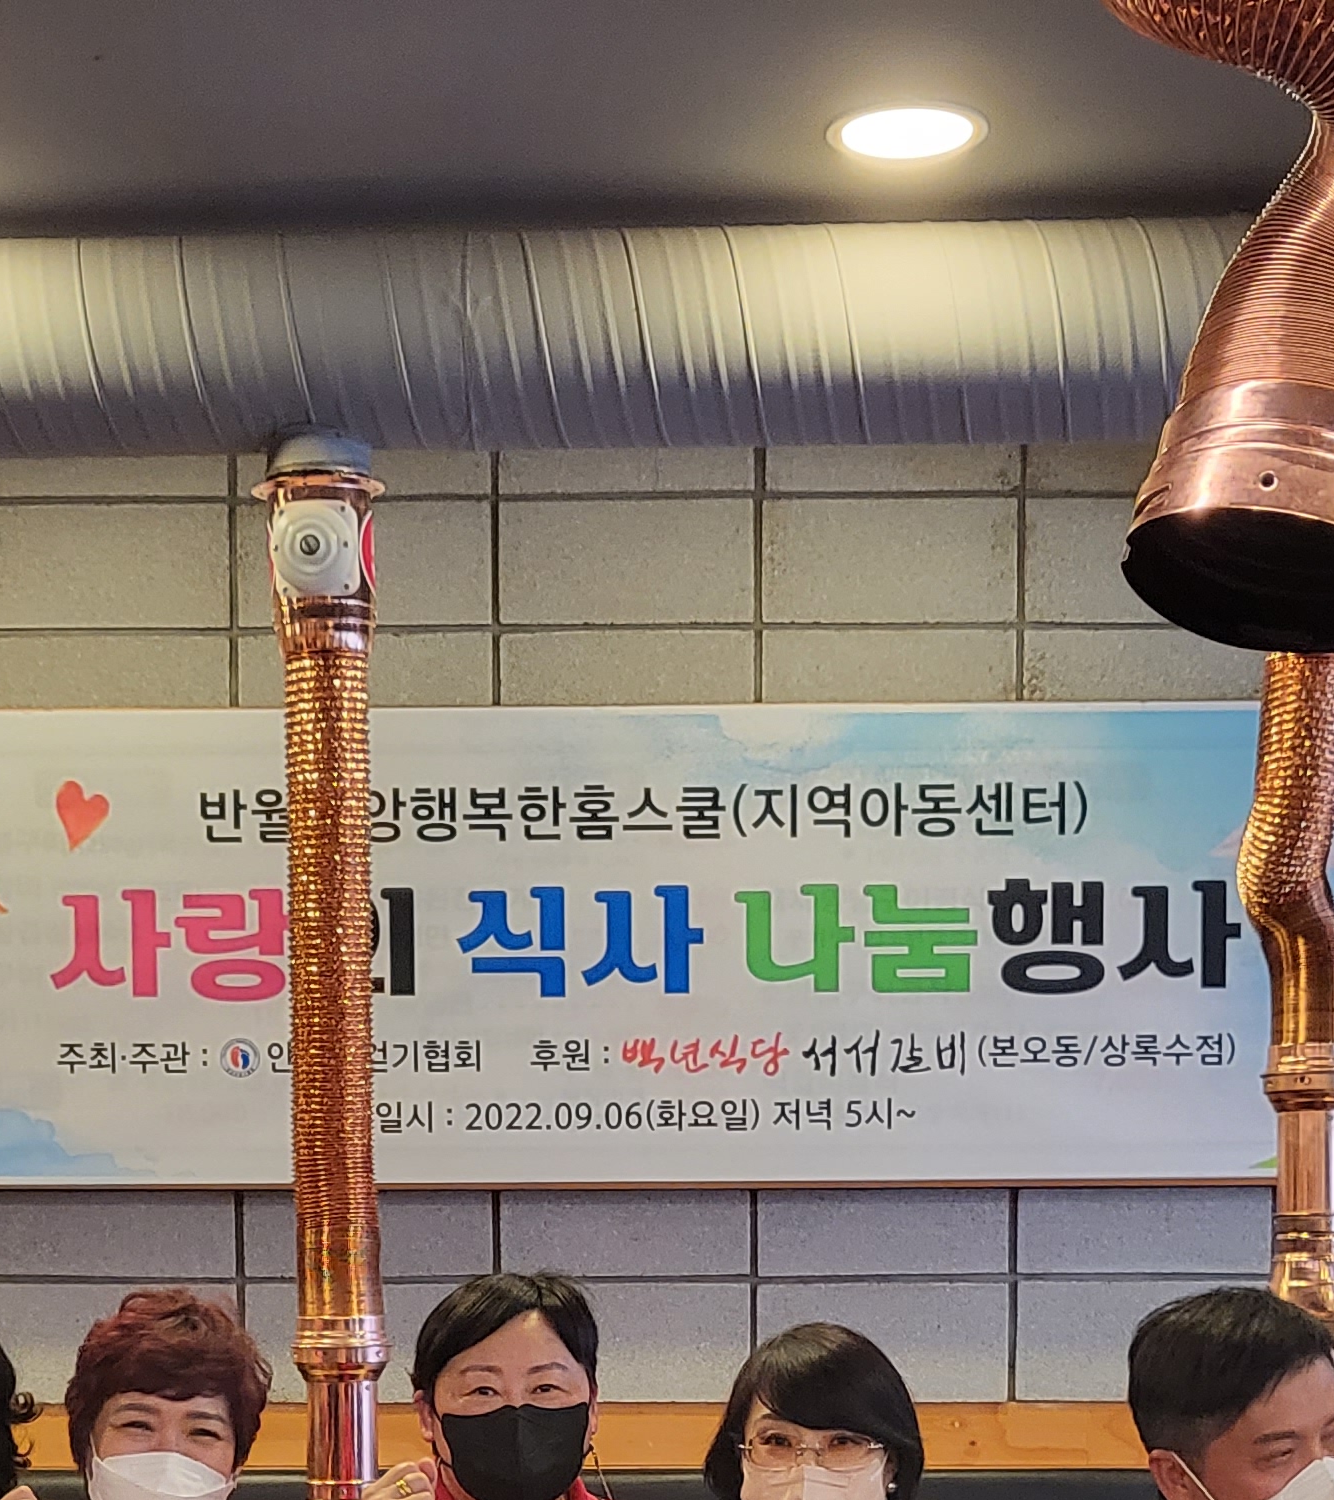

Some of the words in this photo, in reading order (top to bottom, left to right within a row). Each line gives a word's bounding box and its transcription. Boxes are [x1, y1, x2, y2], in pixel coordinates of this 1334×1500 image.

[200, 780, 1090, 846] 반월앙행복한홈스쿨(지역아동센터)
[456, 884, 705, 1000] 식사
[57, 1041, 192, 1076] 주최·주관
[530, 1039, 593, 1074] 후원
[621, 1031, 791, 1079] 백년식당
[802, 1029, 968, 1079] 서서갈비
[978, 1033, 1238, 1071] (본오동/상록수점)
[375, 1101, 435, 1136] 일시
[465, 1098, 762, 1135] 2022.09.06(화요일)
[773, 1098, 834, 1133] 저녁
[845, 1097, 917, 1132] 5시~
